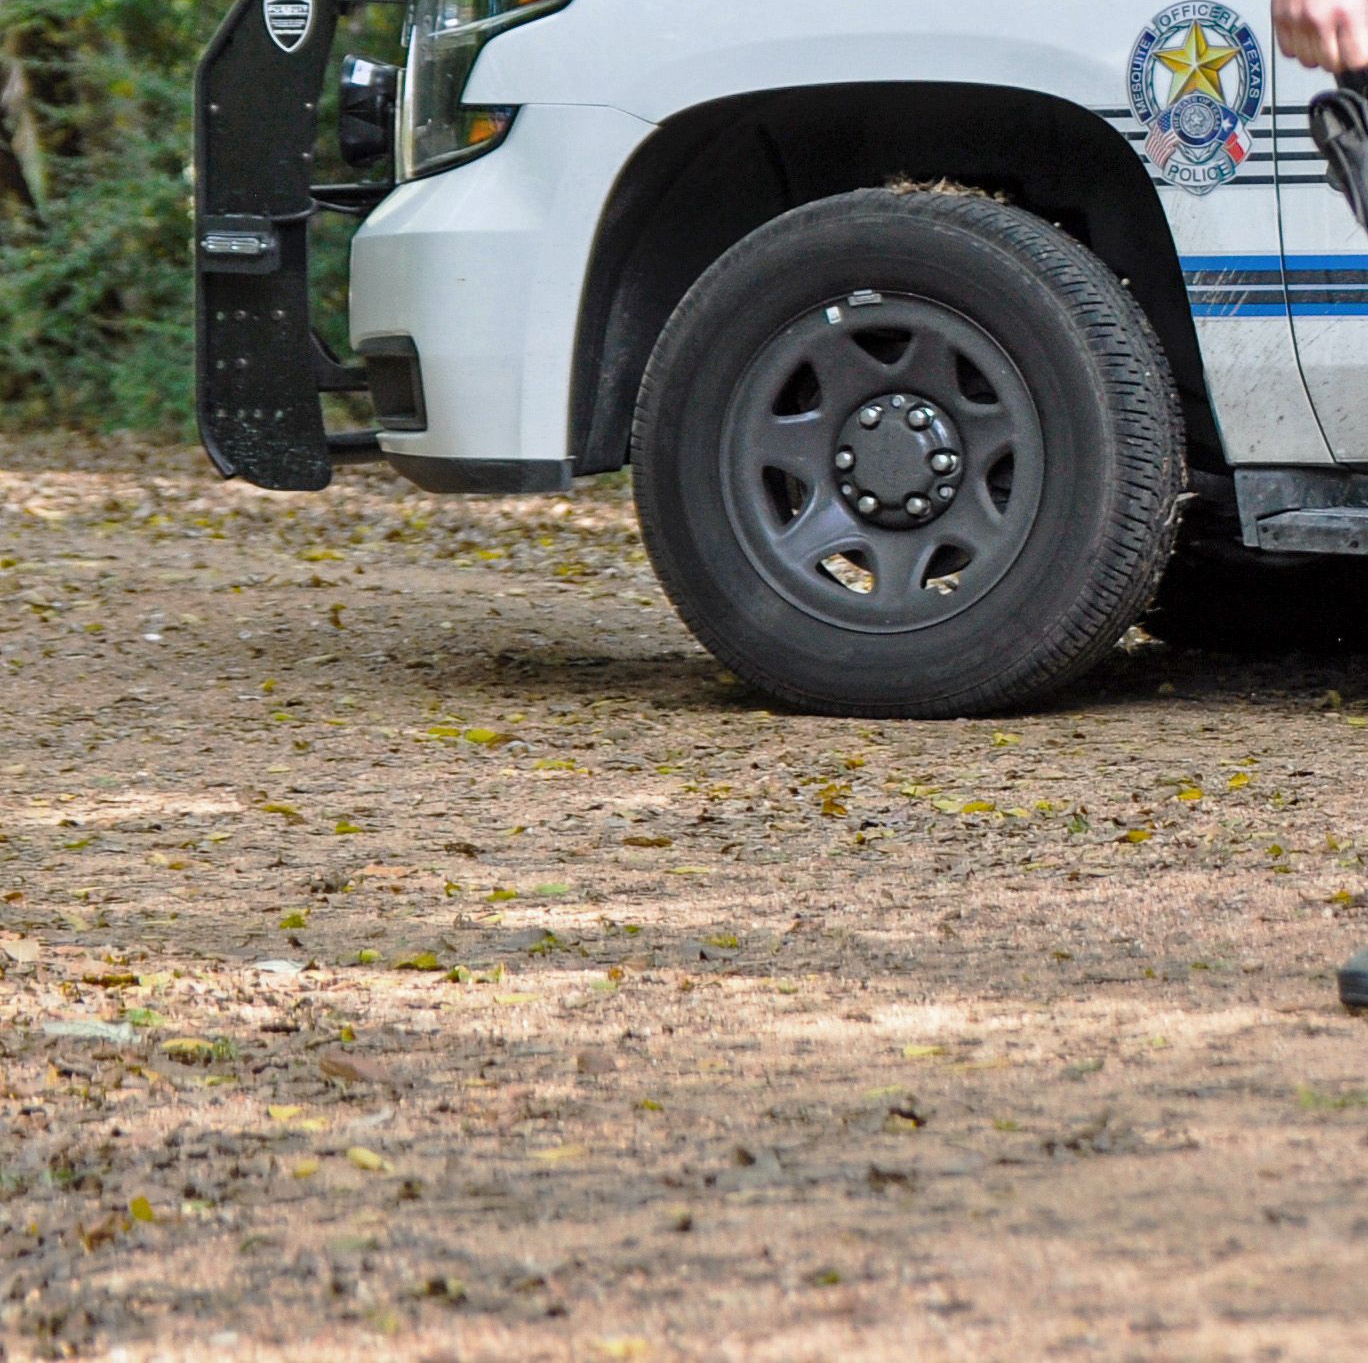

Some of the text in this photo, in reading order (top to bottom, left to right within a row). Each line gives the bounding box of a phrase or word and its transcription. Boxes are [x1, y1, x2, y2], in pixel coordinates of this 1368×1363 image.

[1159, 4, 1231, 28] OFFICER
[1129, 39, 1148, 113] MESQUITE
[1242, 39, 1260, 98] TEXAS
[1167, 162, 1231, 182] POLICE
